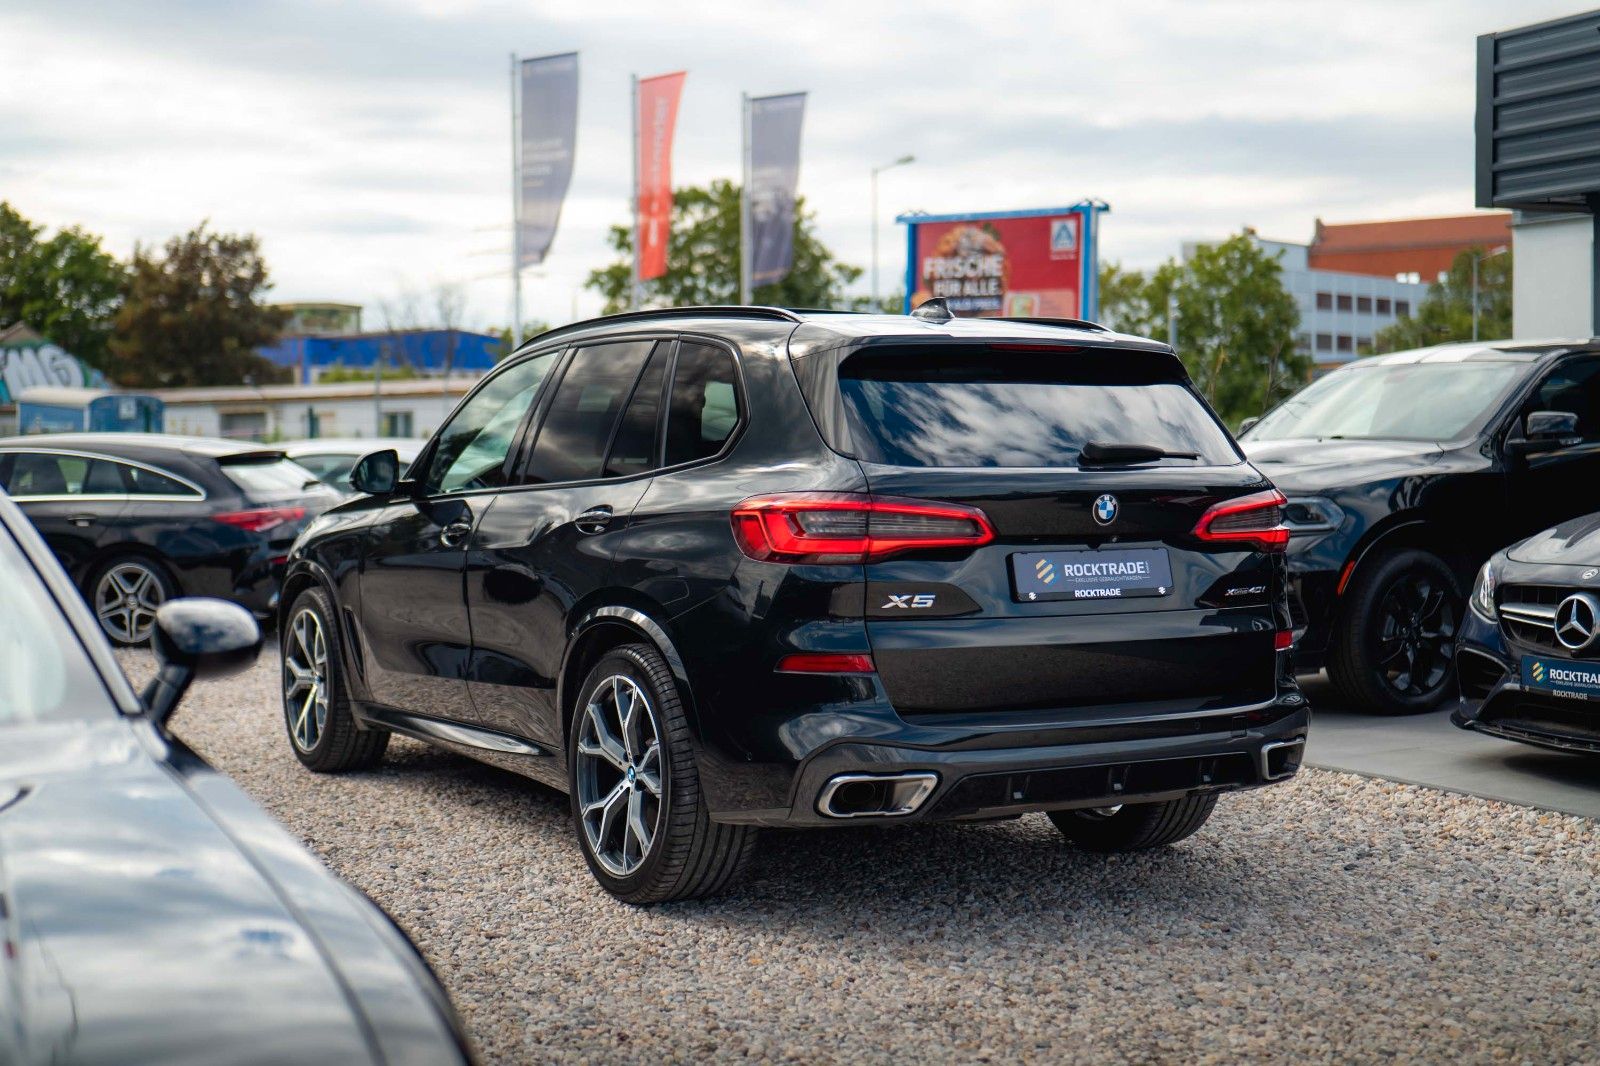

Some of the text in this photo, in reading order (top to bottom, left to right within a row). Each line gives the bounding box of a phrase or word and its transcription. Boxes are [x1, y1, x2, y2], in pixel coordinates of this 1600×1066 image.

[1064, 561, 1145, 576] ROCKTRADE
[1074, 588, 1121, 597] ROCKTRADE
[881, 594, 936, 609] X5
[1552, 689, 1588, 700] ROCKTRADE
